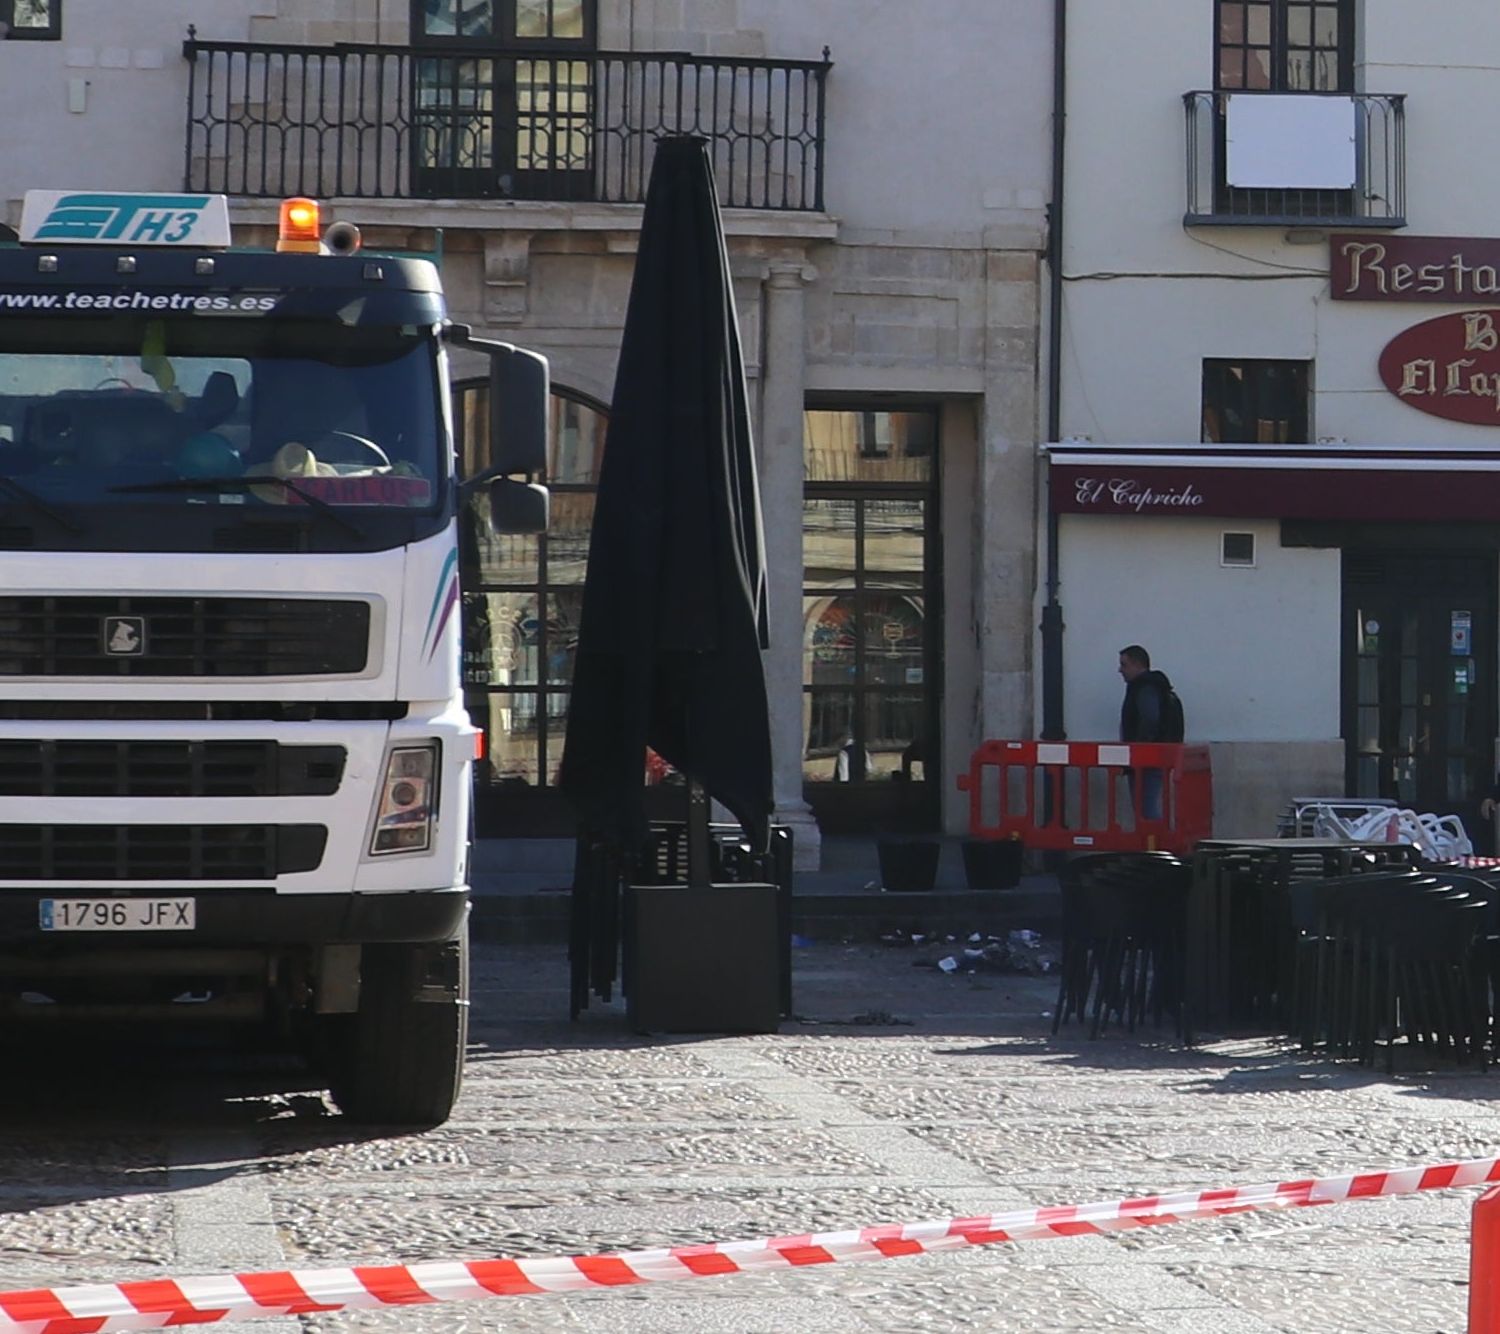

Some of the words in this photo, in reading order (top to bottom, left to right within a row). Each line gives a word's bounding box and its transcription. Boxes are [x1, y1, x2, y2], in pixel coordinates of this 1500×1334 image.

[1397, 358, 1438, 397] El
[1075, 477, 1106, 504] El
[1107, 477, 1204, 513] Capricho
[61, 902, 127, 926] 1796
[139, 901, 190, 926] JFX
